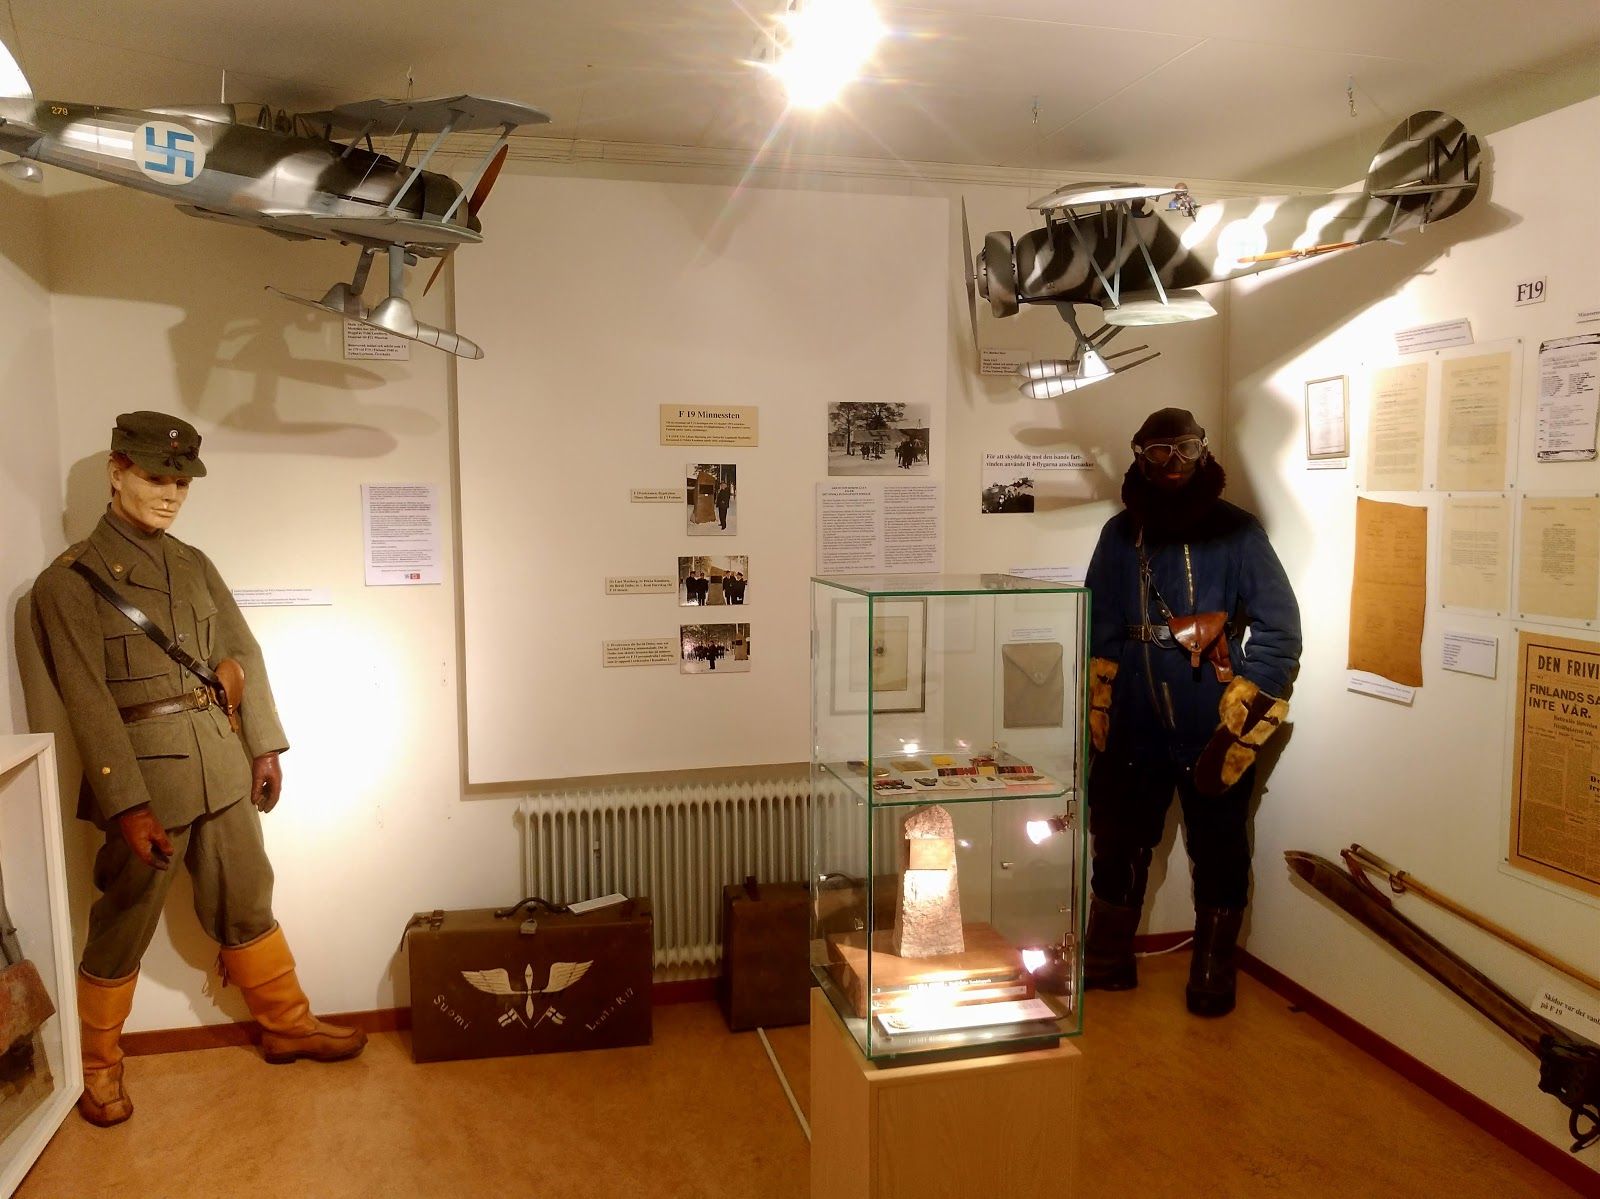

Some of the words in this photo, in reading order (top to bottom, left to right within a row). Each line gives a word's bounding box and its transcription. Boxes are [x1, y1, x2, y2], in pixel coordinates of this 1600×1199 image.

[1516, 280, 1544, 302] F19
[679, 410, 684, 418] F
[687, 410, 696, 418] 19
[697, 411, 740, 419] Minnessten
[1537, 655, 1561, 673] DEN
[1567, 659, 1600, 680] FRIVI
[1529, 683, 1584, 703] FINLANDS
[1528, 696, 1555, 712] INTE
[1561, 703, 1592, 719] VÅR.
[433, 994, 470, 1031] Suomi
[1544, 993, 1563, 1006] Skidor
[1564, 1003, 1575, 1012] var
[1555, 1008, 1563, 1016] 19
